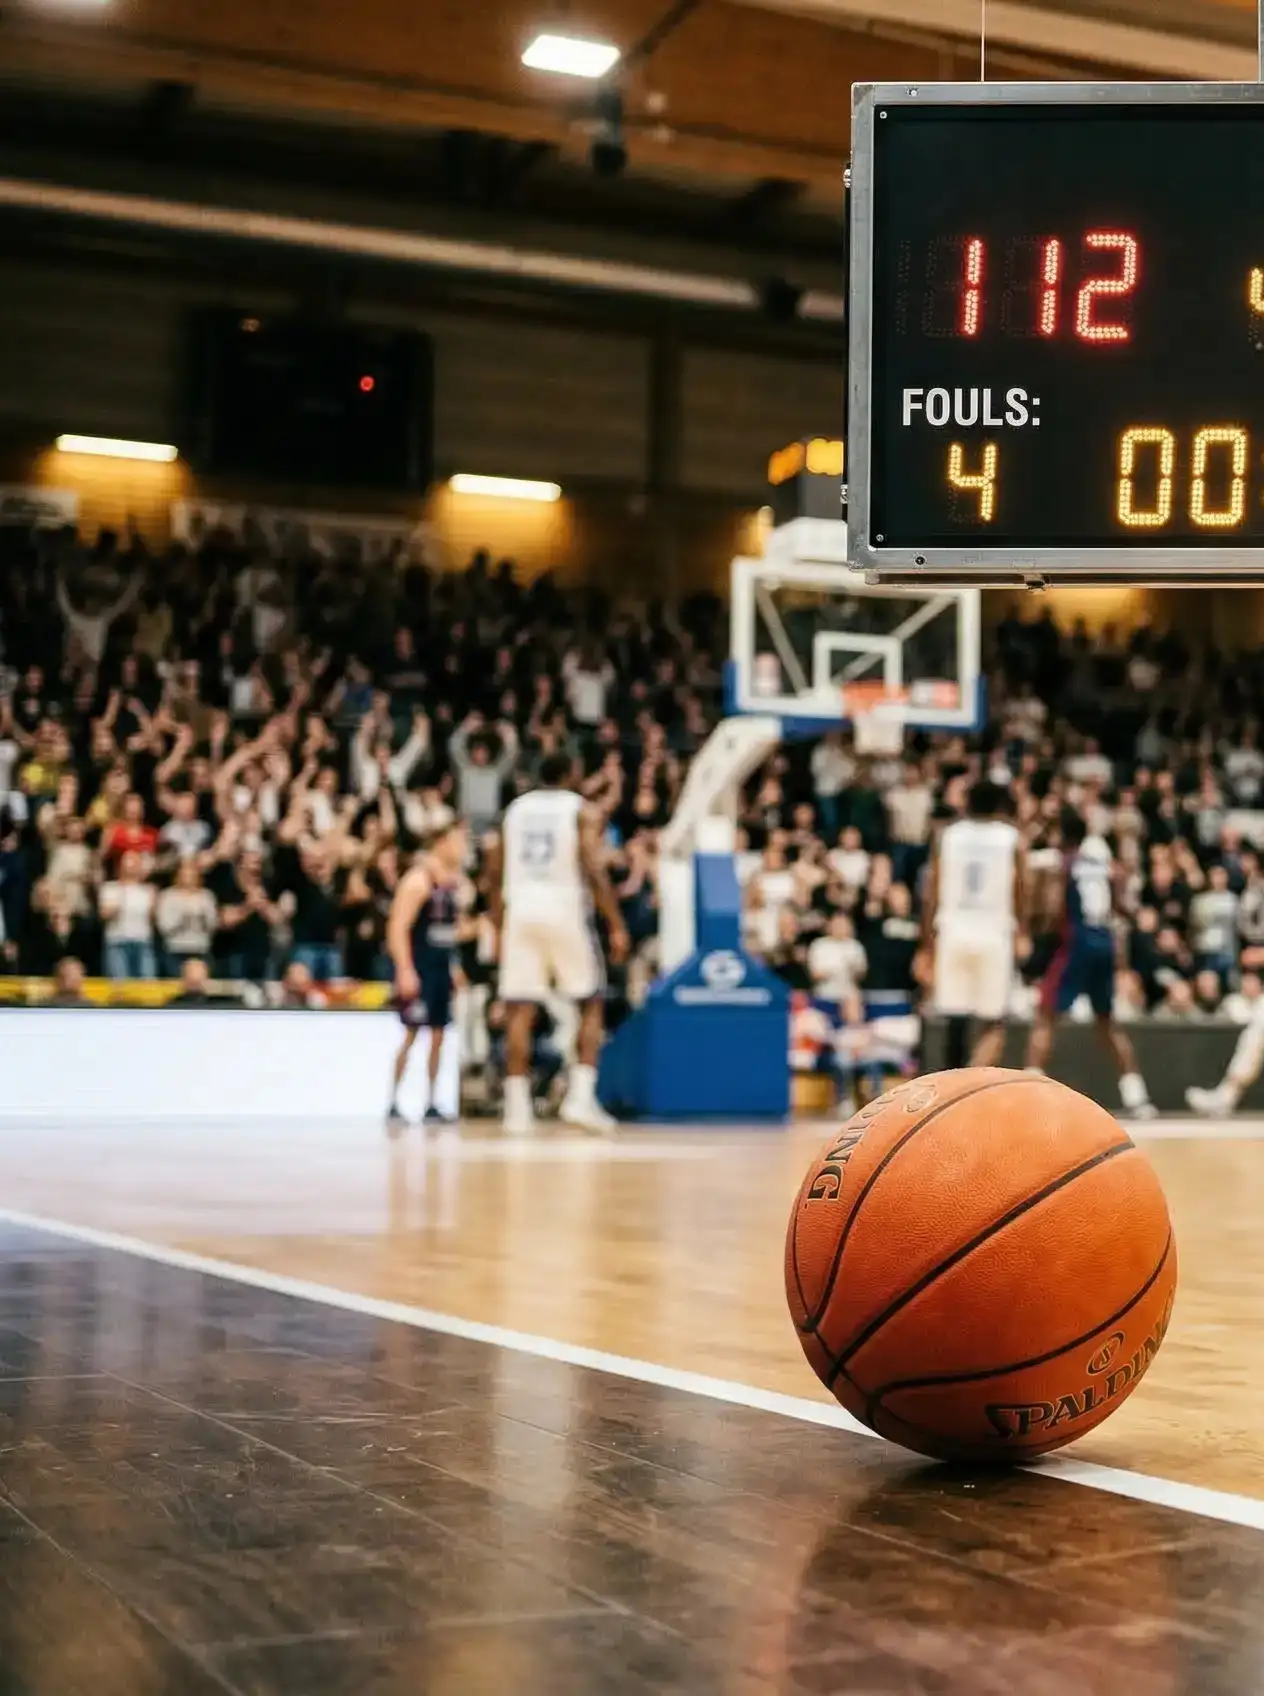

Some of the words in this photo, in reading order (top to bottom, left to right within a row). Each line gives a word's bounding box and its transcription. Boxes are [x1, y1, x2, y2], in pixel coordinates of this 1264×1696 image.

[961, 231, 1139, 343] 112
[903, 387, 1040, 427] FOULS:
[948, 443, 998, 522] 4
